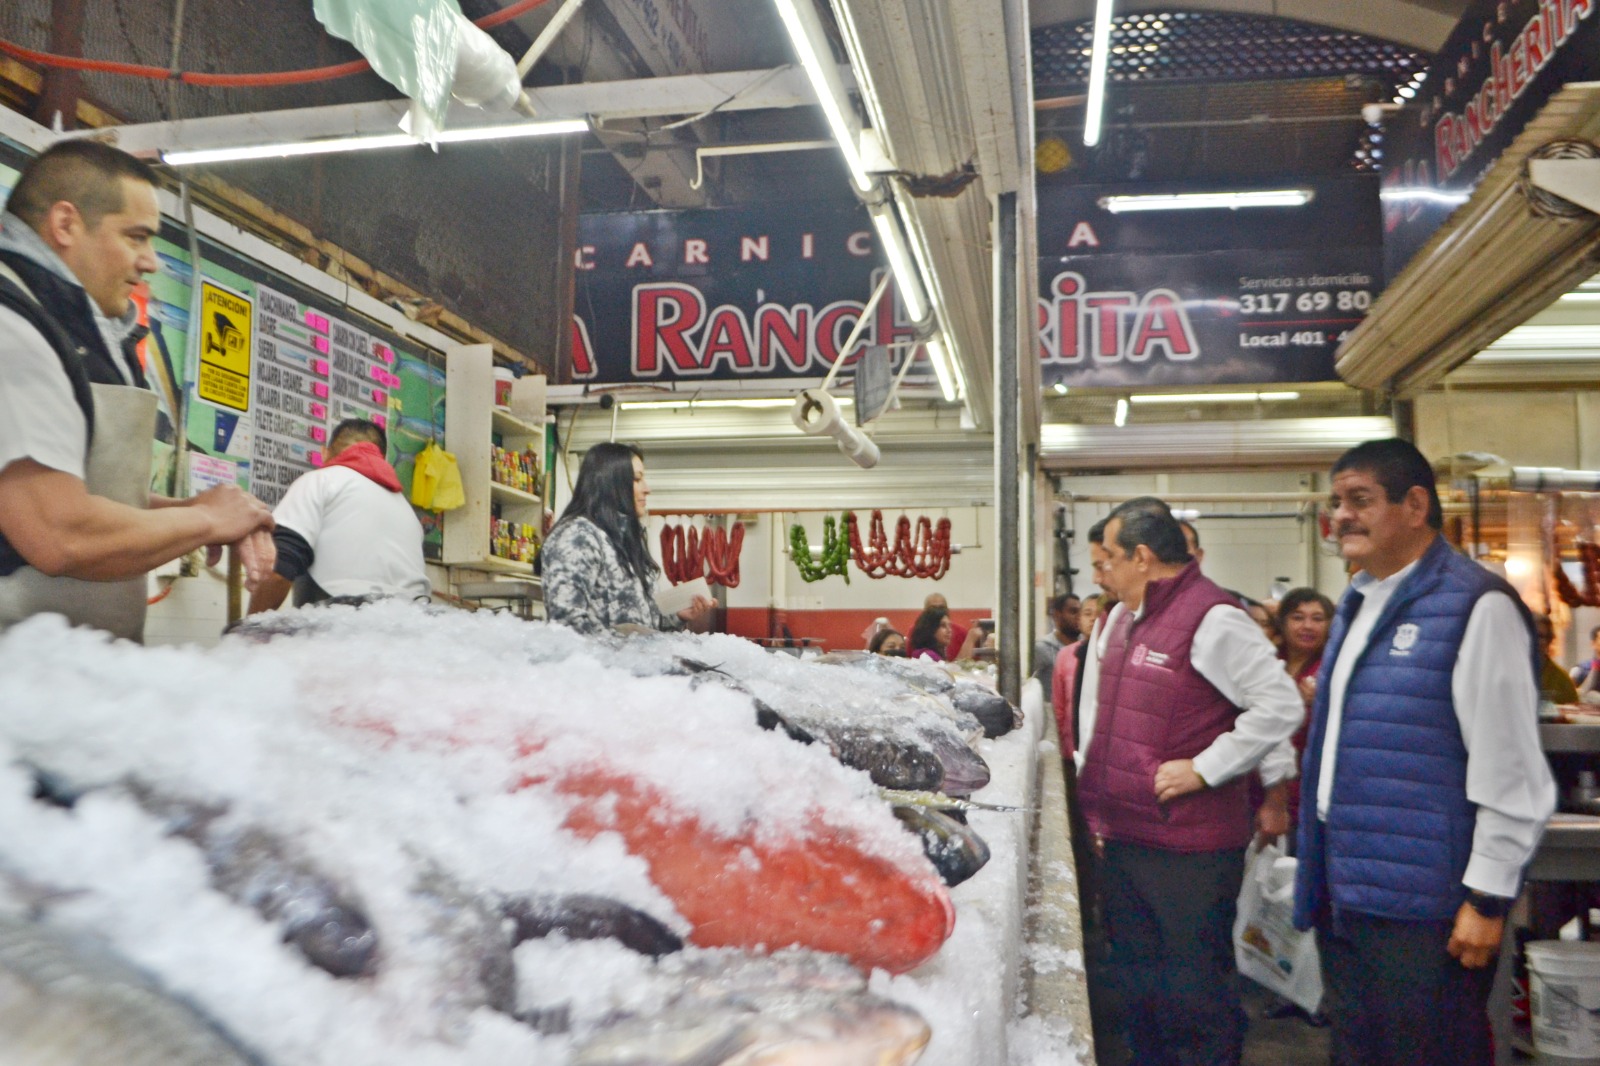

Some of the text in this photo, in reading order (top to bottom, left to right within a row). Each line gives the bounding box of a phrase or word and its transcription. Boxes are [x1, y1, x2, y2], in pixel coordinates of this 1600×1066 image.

[1239, 272, 1370, 288] Servicio a domicilio
[1240, 290, 1371, 313] 317 69 80
[1240, 331, 1288, 347] Local
[1290, 331, 1325, 346] 401
